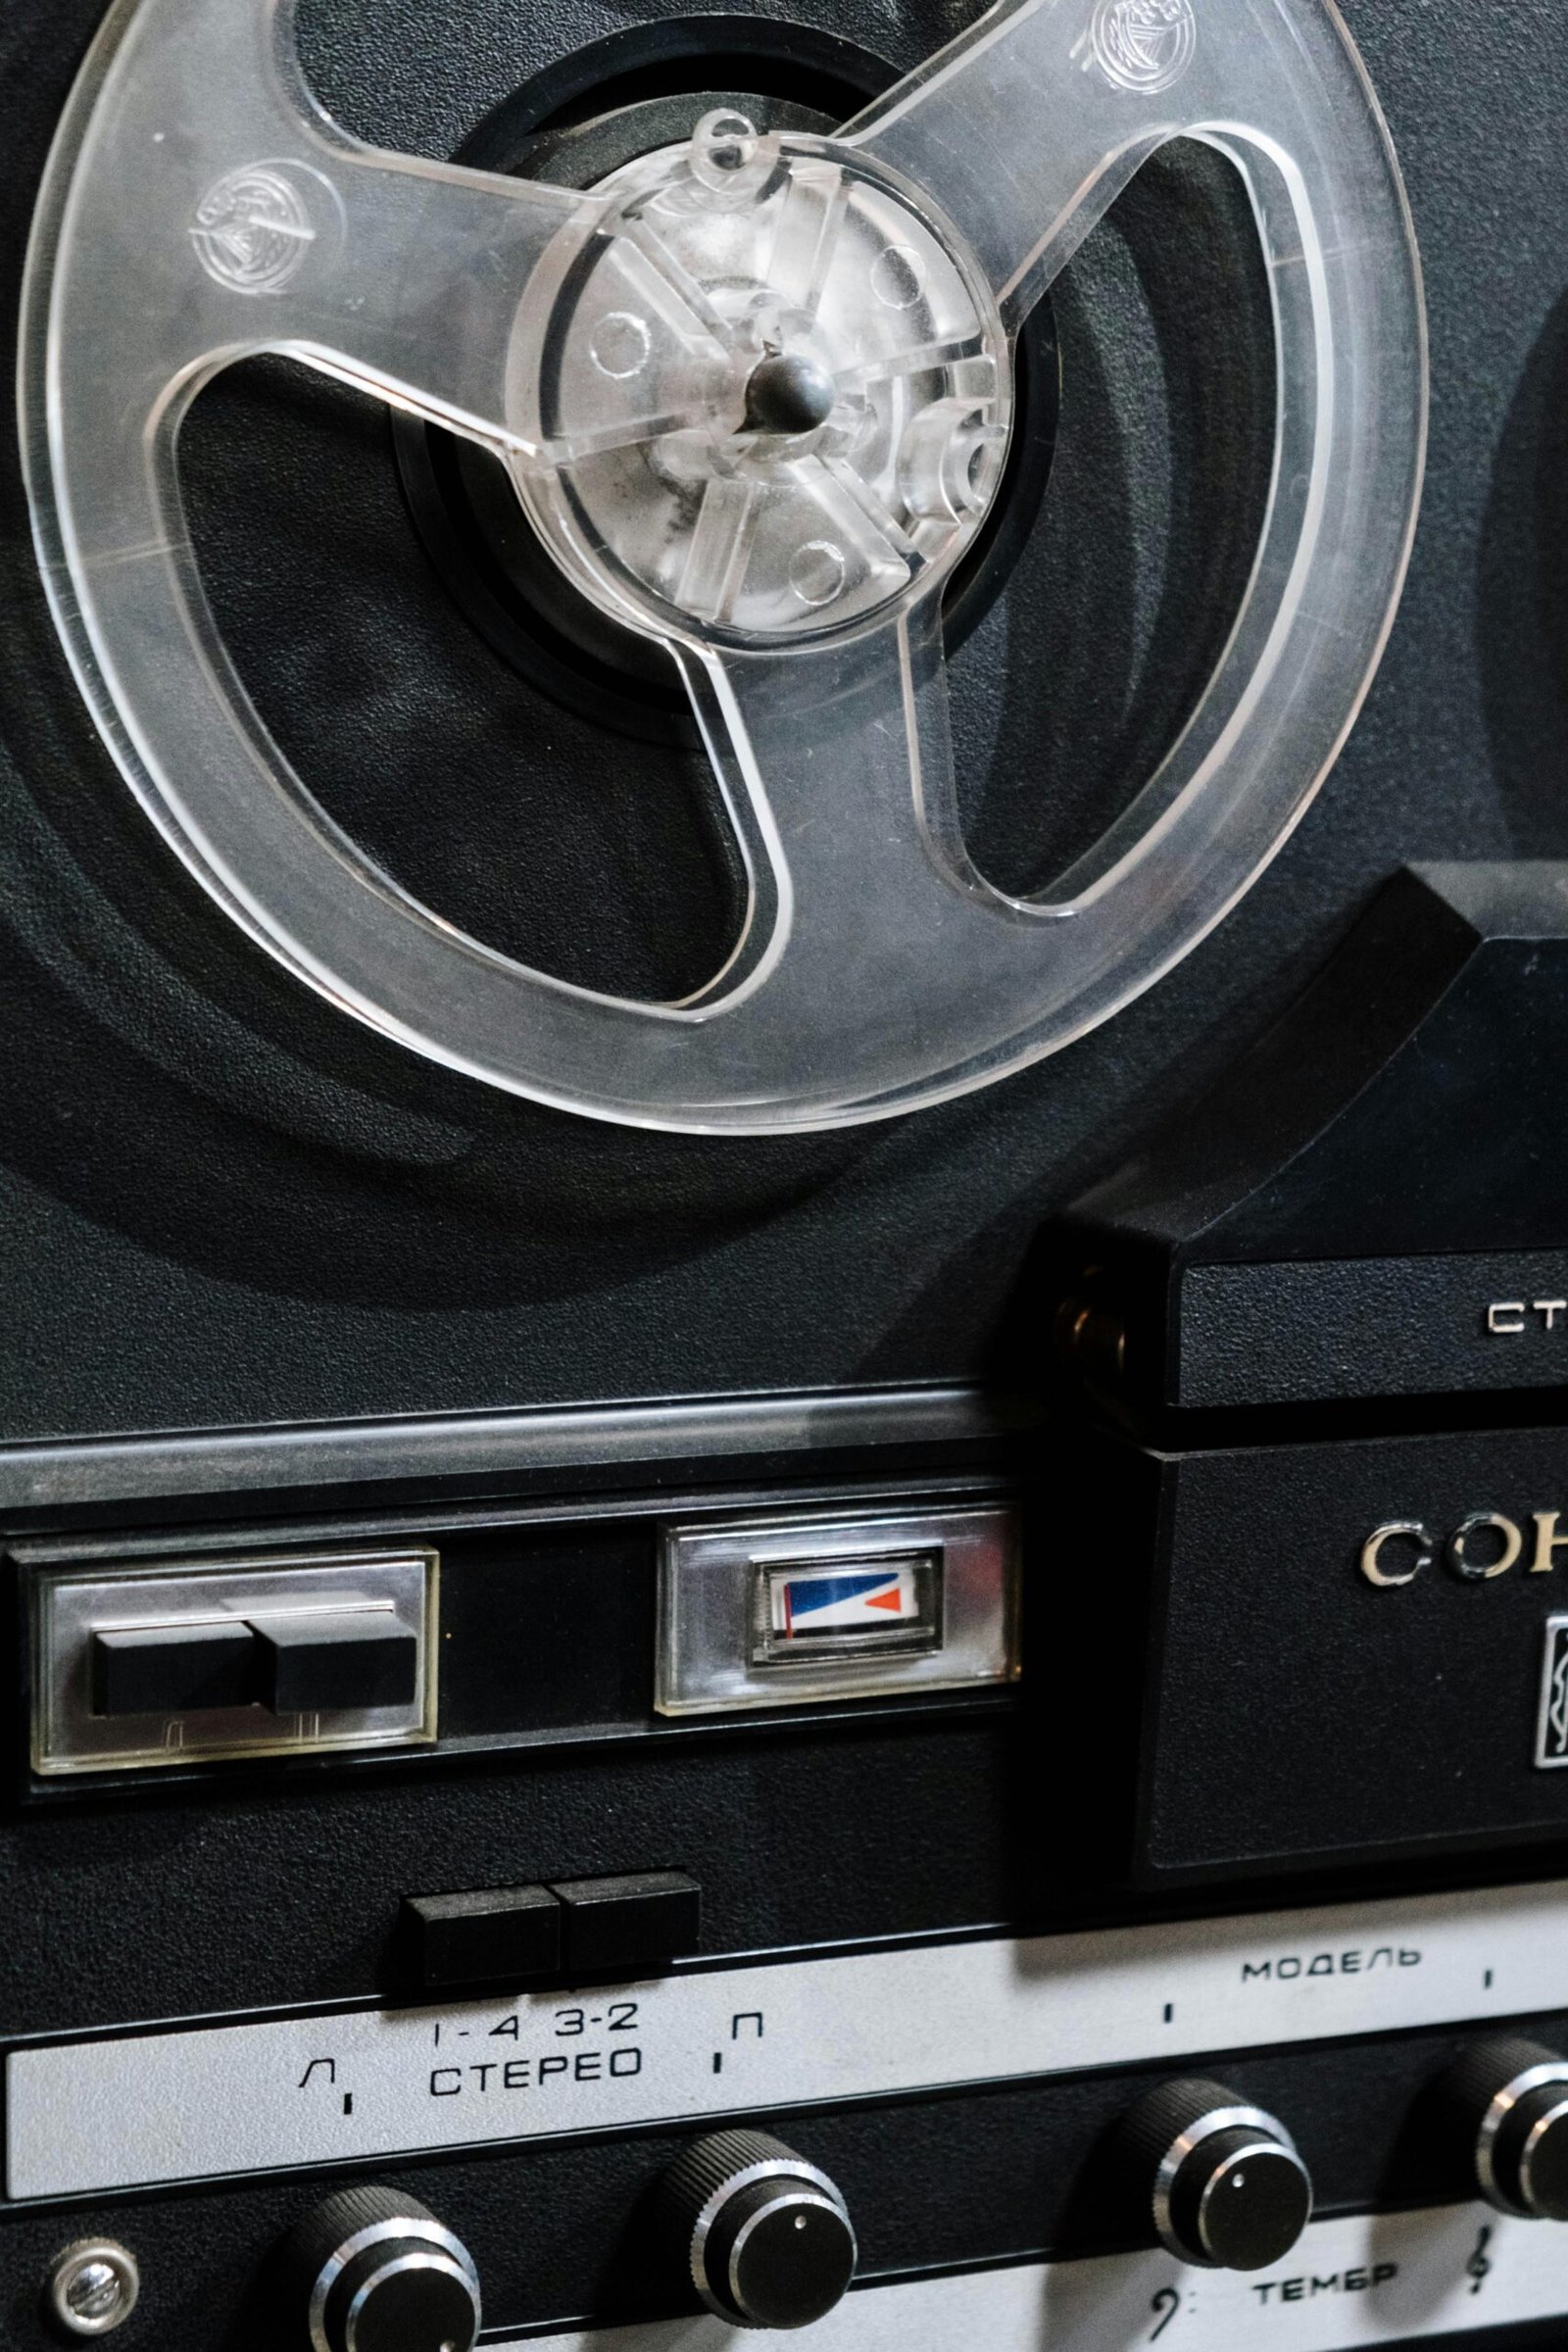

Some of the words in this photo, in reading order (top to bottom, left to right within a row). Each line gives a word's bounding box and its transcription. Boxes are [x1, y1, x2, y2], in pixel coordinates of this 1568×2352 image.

[1242, 1945, 1422, 1983] МОДЕЛЬ
[554, 2002, 639, 2036] 3-2
[731, 2012, 763, 2039] П
[297, 2057, 336, 2088] Л
[428, 2047, 642, 2097] СТЕРЕО
[1252, 2263, 1398, 2305] ТЕМБР
